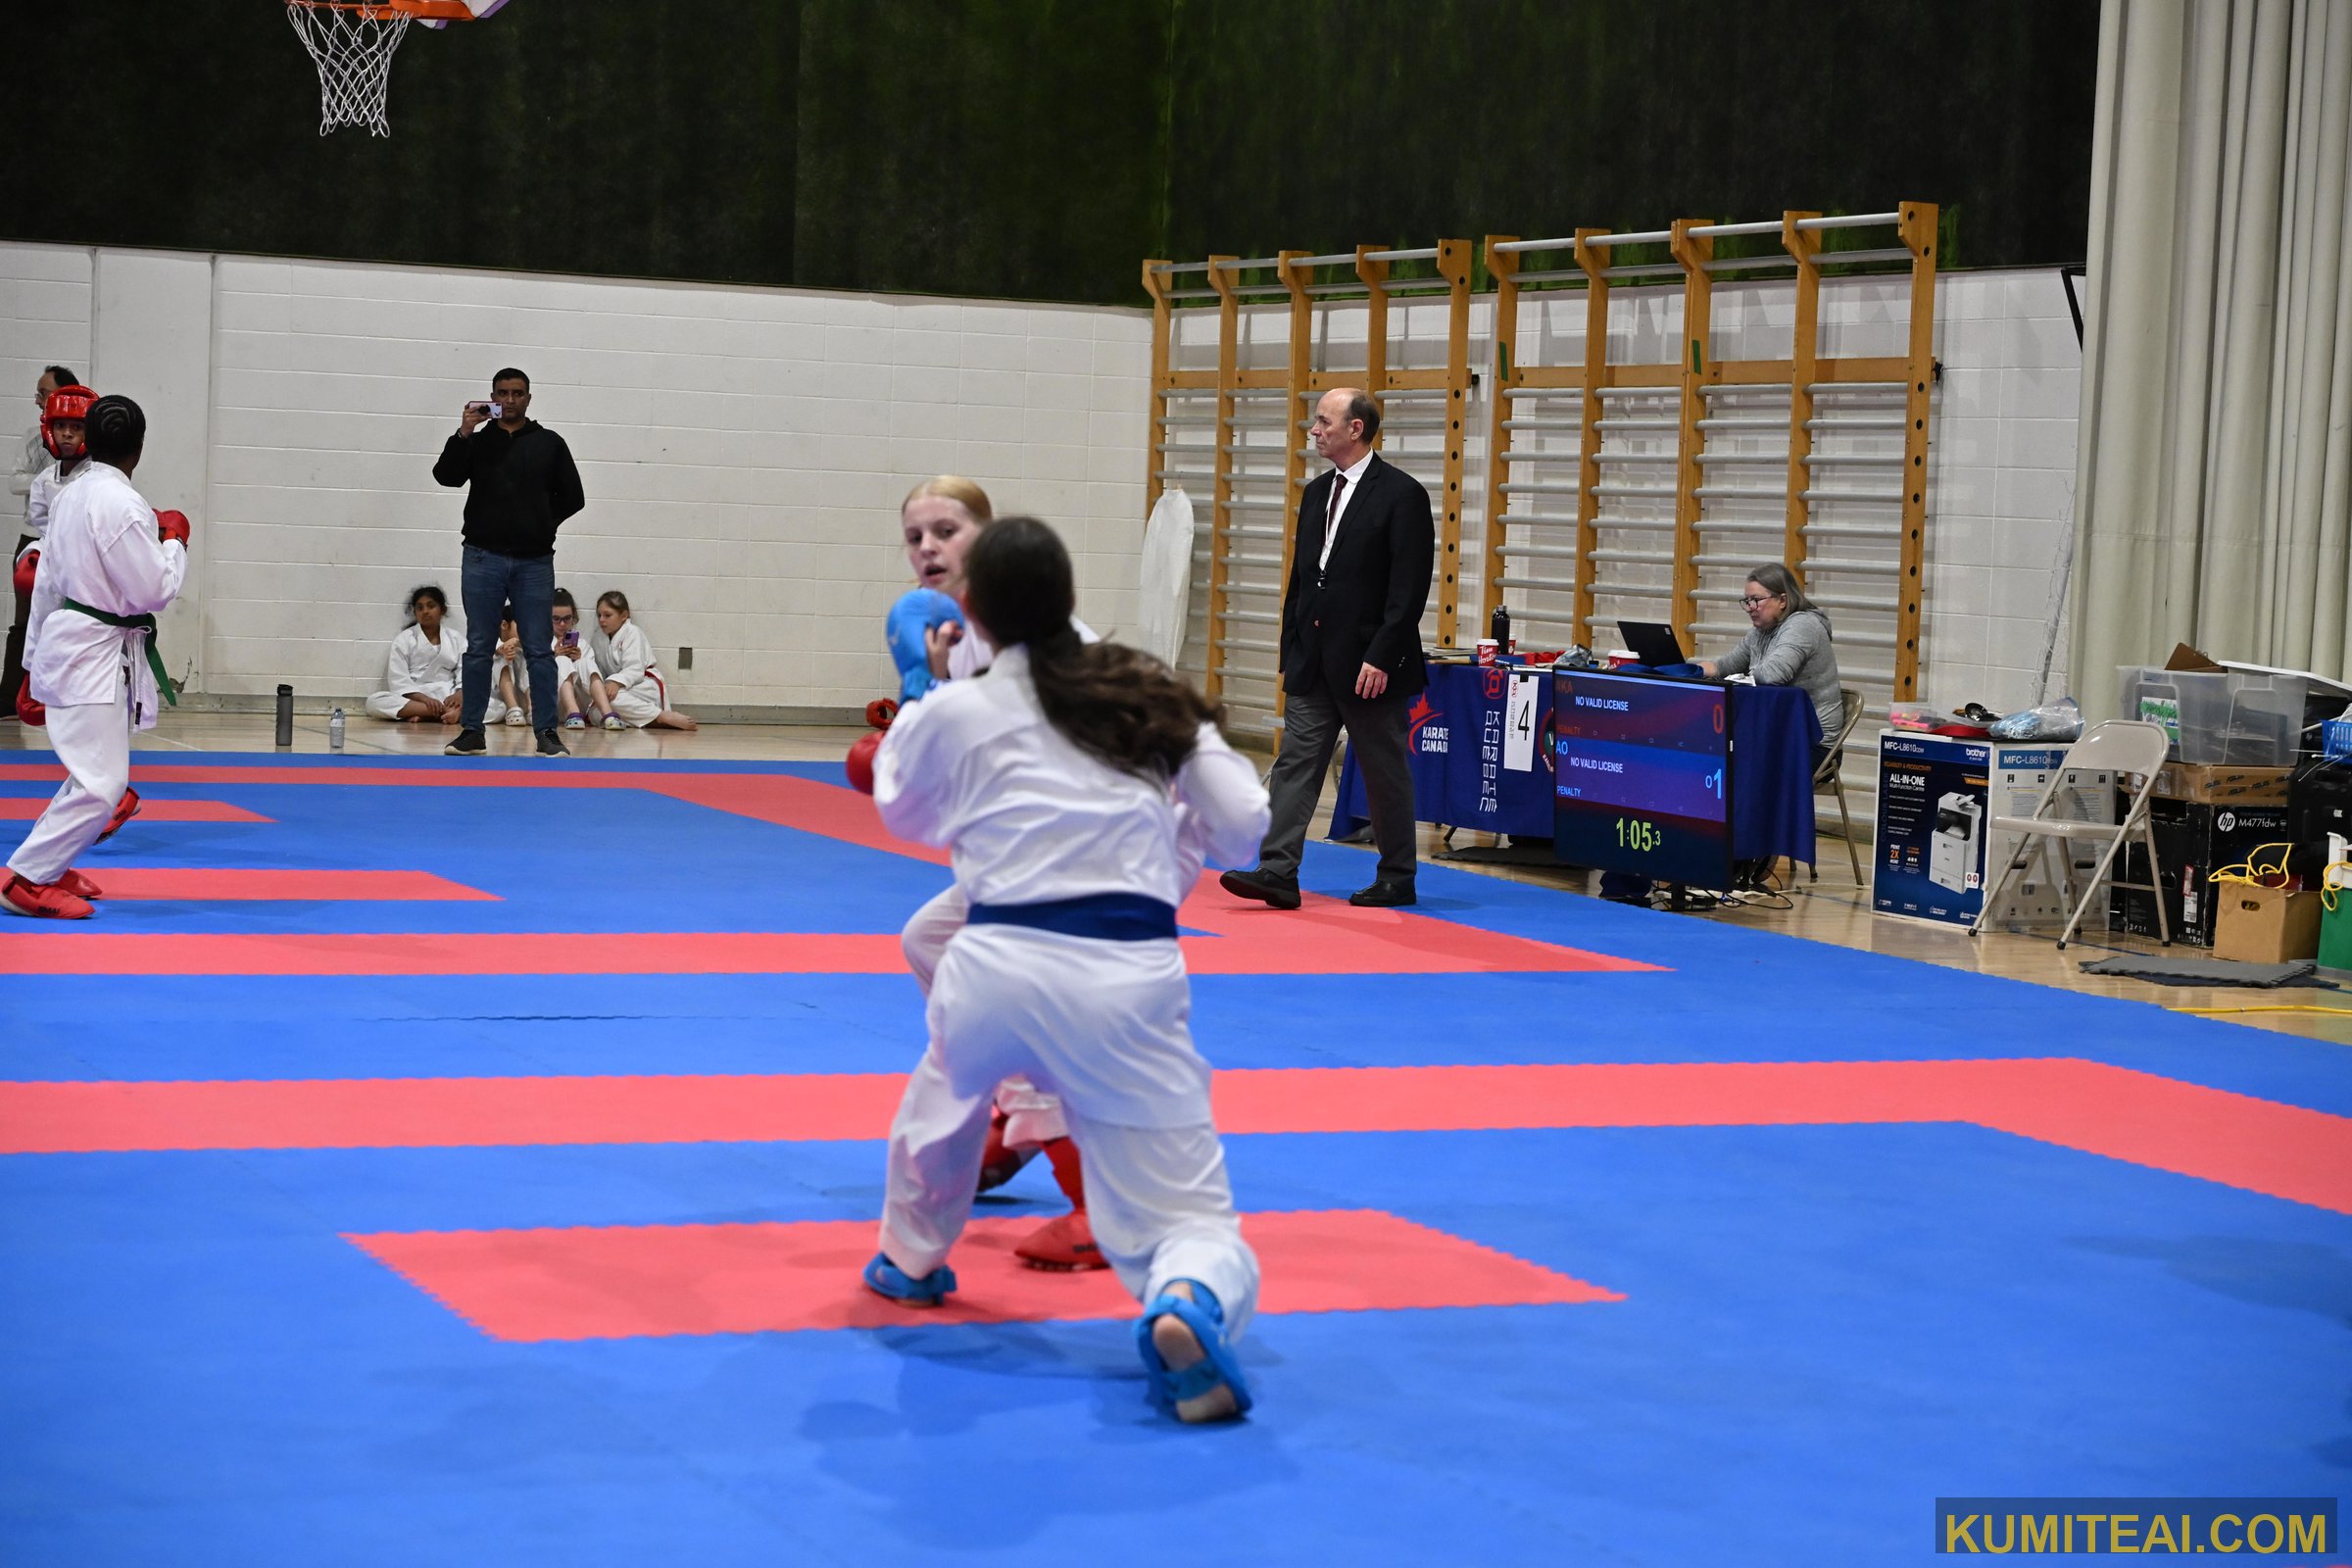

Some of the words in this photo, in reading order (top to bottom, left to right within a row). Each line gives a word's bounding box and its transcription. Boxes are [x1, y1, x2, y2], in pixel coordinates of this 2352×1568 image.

[1575, 696, 1585, 706] NO
[1585, 697, 1602, 709] VALID
[1603, 699, 1629, 711] LICENSE
[1518, 700, 1530, 741] 4
[1713, 705, 1724, 734] 0
[1555, 740, 1569, 756] AO
[1965, 748, 1986, 758] brother
[1570, 757, 1580, 767] NO
[1580, 758, 1597, 769] VALID
[1598, 760, 1624, 773] LICENSE
[1889, 773, 1925, 786] ALL-IN-ONE
[1556, 785, 1582, 797] PENALTY
[2219, 812, 2234, 831] hp
[2238, 818, 2277, 828] M477fdw
